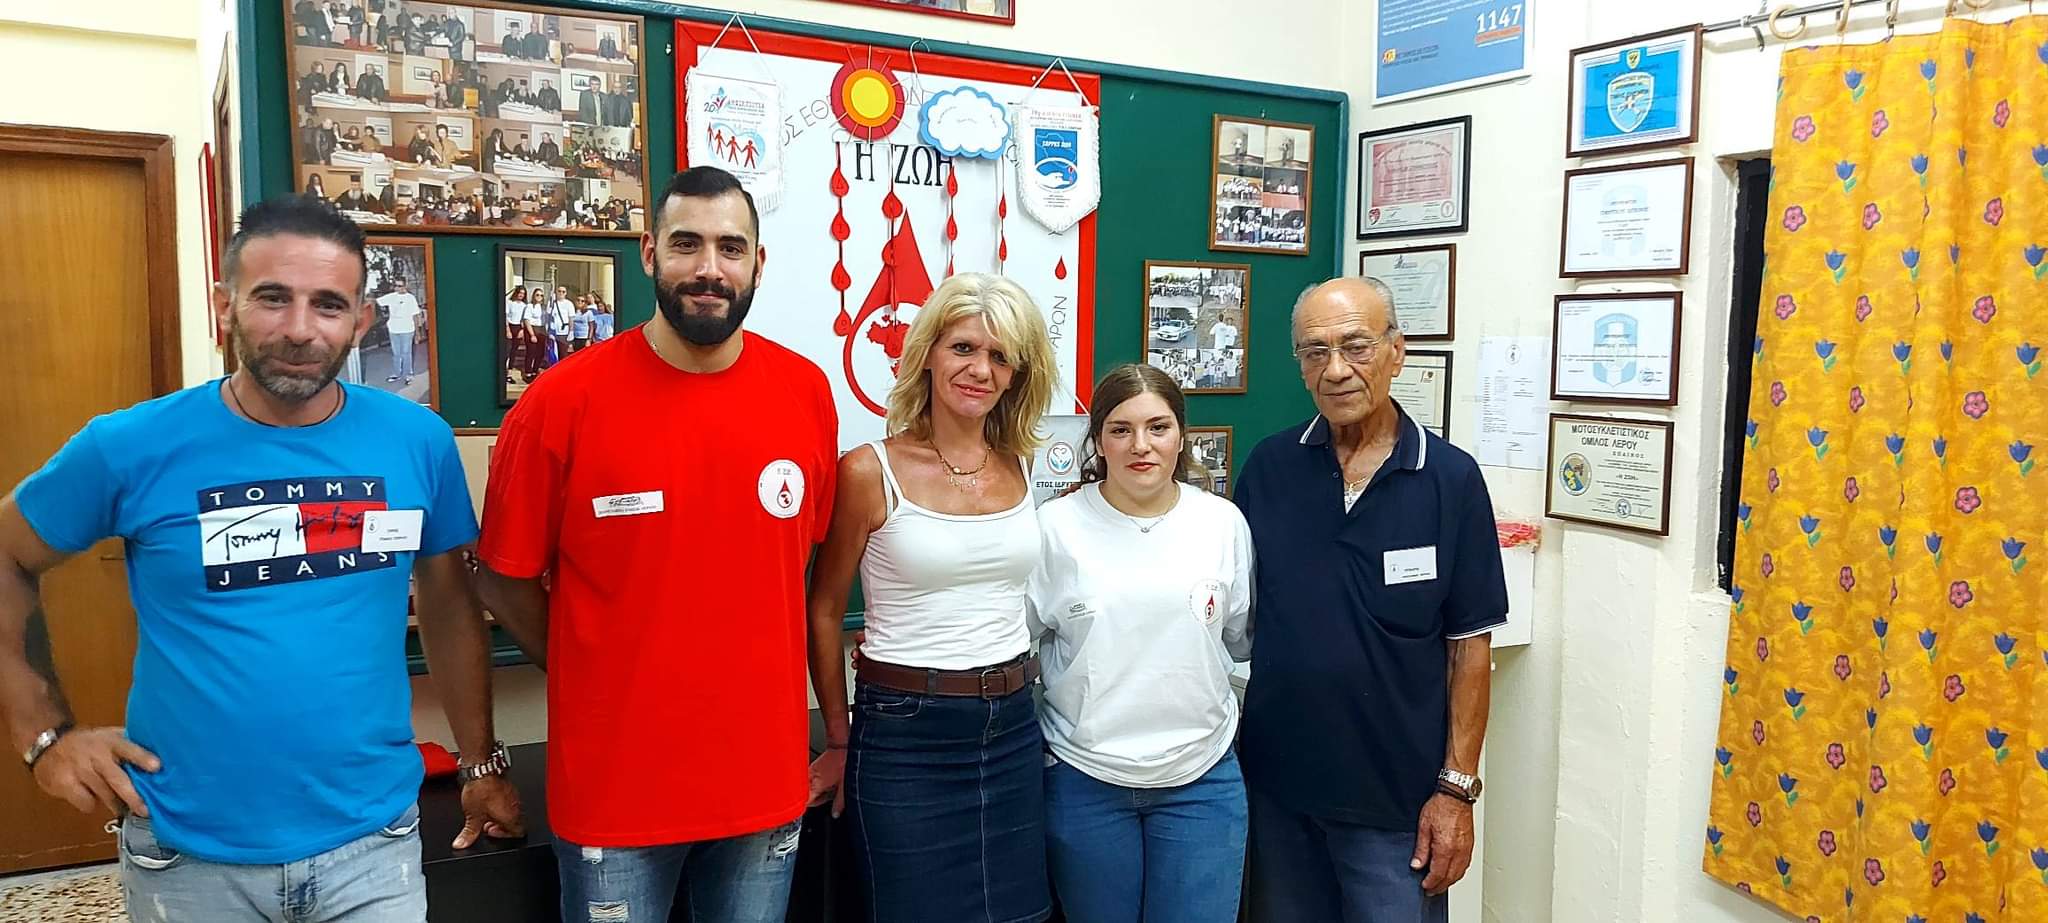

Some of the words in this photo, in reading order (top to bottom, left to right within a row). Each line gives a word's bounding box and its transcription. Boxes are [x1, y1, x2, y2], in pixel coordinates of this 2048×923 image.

[1476, 4, 1523, 34] 1147
[855, 142, 876, 182] Η
[894, 143, 953, 187] ΖΩΗ
[1571, 424, 1650, 440] ΜΟΤΟΣΥΚΛΕΤΙΣΤΙΚΟΣ
[1581, 436, 1609, 447] ΟΜΙΛΟΣ
[1611, 439, 1638, 450] ΛΕΡΟΥ
[209, 482, 376, 506] TOMMY
[218, 551, 388, 586] JEANS
